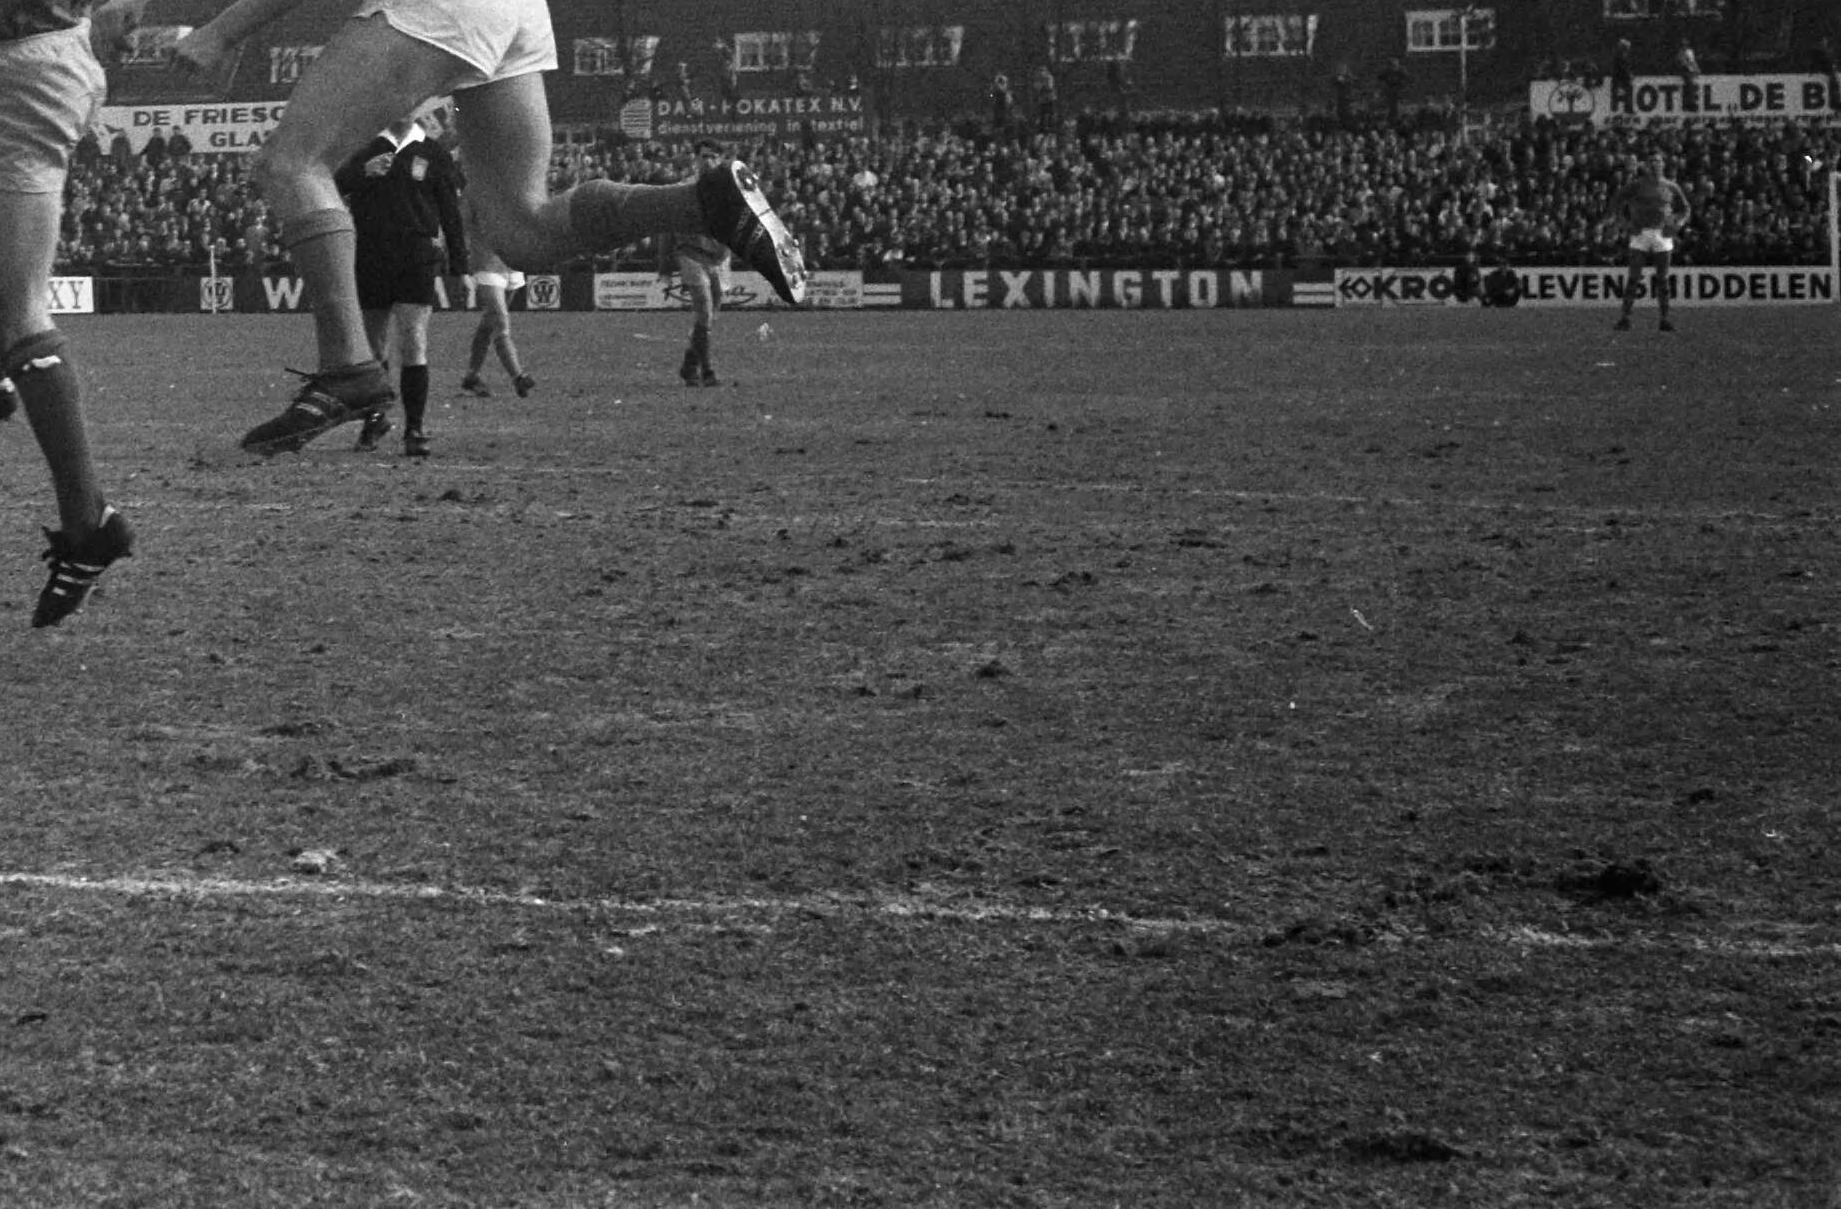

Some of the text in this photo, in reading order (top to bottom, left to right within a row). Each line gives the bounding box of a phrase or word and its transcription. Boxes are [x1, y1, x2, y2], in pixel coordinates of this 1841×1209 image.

[133, 105, 286, 127] DE FRIESC
[48, 280, 83, 310] XY
[930, 270, 1263, 308] LEXINGTON
[1372, 275, 1477, 301] KRO
